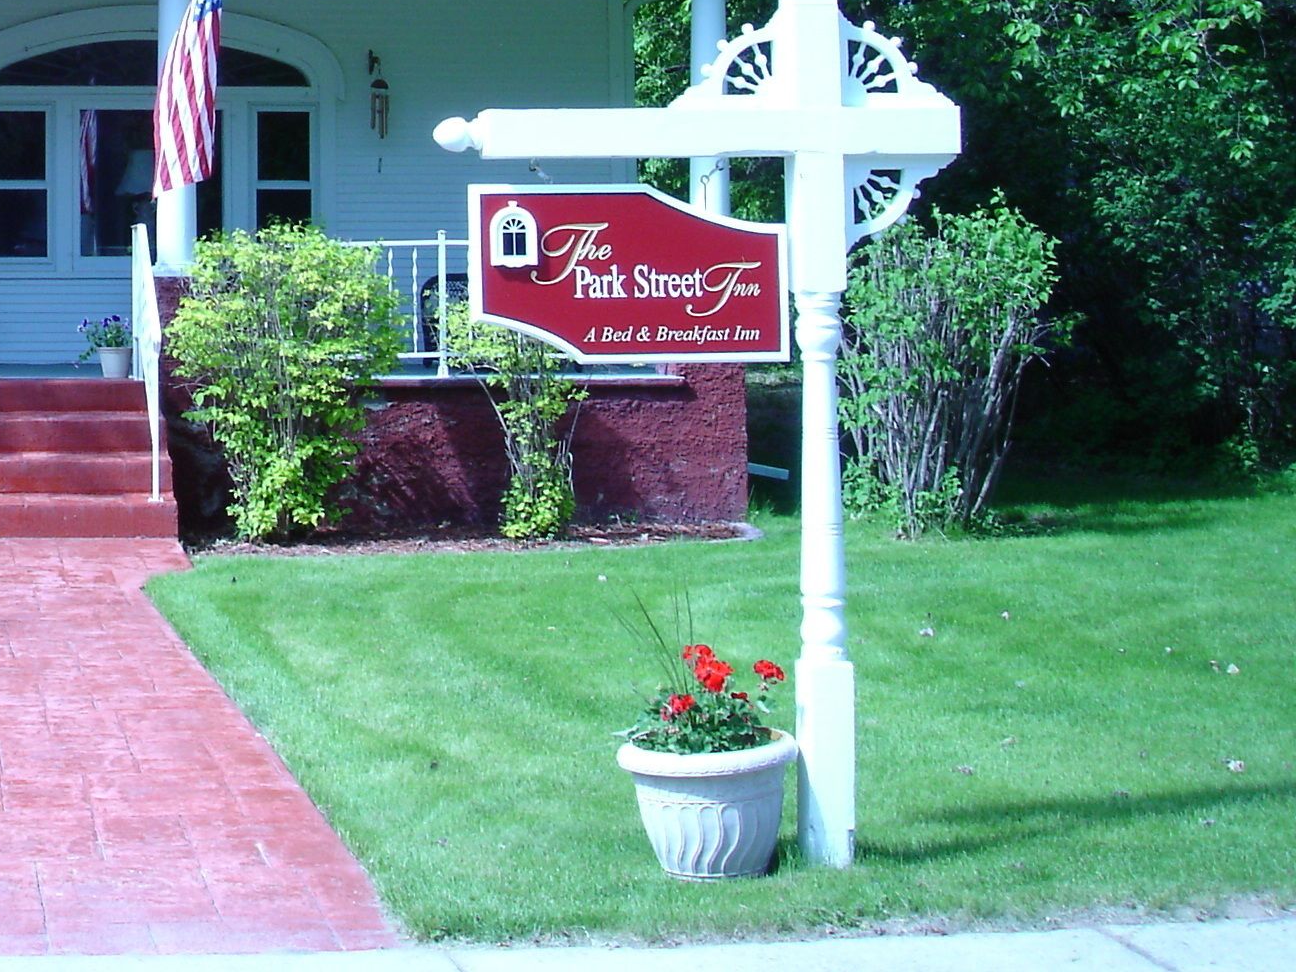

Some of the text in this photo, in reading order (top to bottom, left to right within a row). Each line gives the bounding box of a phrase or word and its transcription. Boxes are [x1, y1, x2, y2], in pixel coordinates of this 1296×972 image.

[530, 222, 612, 285] The
[573, 261, 762, 317] Park Street Inn
[583, 325, 760, 345] A Bed & Breakfast Inn
